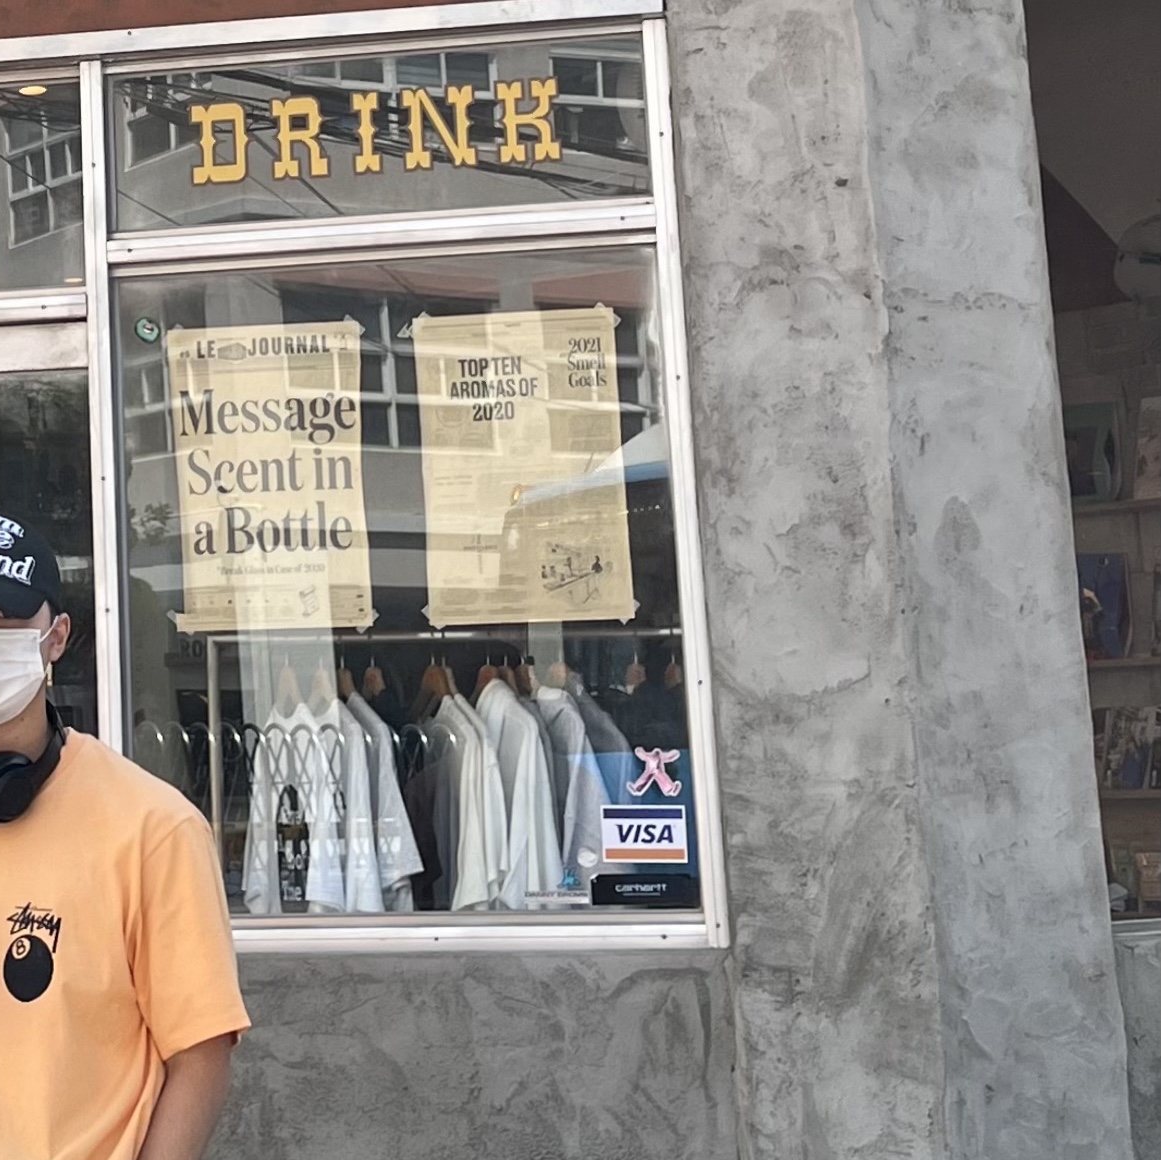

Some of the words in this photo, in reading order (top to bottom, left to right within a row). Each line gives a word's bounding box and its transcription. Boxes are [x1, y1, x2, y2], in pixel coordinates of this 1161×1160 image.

[188, 75, 562, 186] DRINK
[196, 340, 217, 360] LE
[248, 334, 331, 357] JOURNAL
[568, 336, 601, 353] 2021
[458, 357, 488, 378] TOP
[490, 355, 522, 376] TEN
[450, 379, 517, 400] AROMAS
[519, 377, 538, 397] OF
[568, 370, 607, 388] Goals
[179, 388, 356, 446] Message
[472, 400, 514, 422] 2020
[188, 447, 304, 496] Scent
[313, 447, 354, 491] in
[193, 519, 217, 555] a
[225, 500, 354, 555] Bottle
[615, 824, 674, 844] VISA
[16, 940, 26, 956] 8
